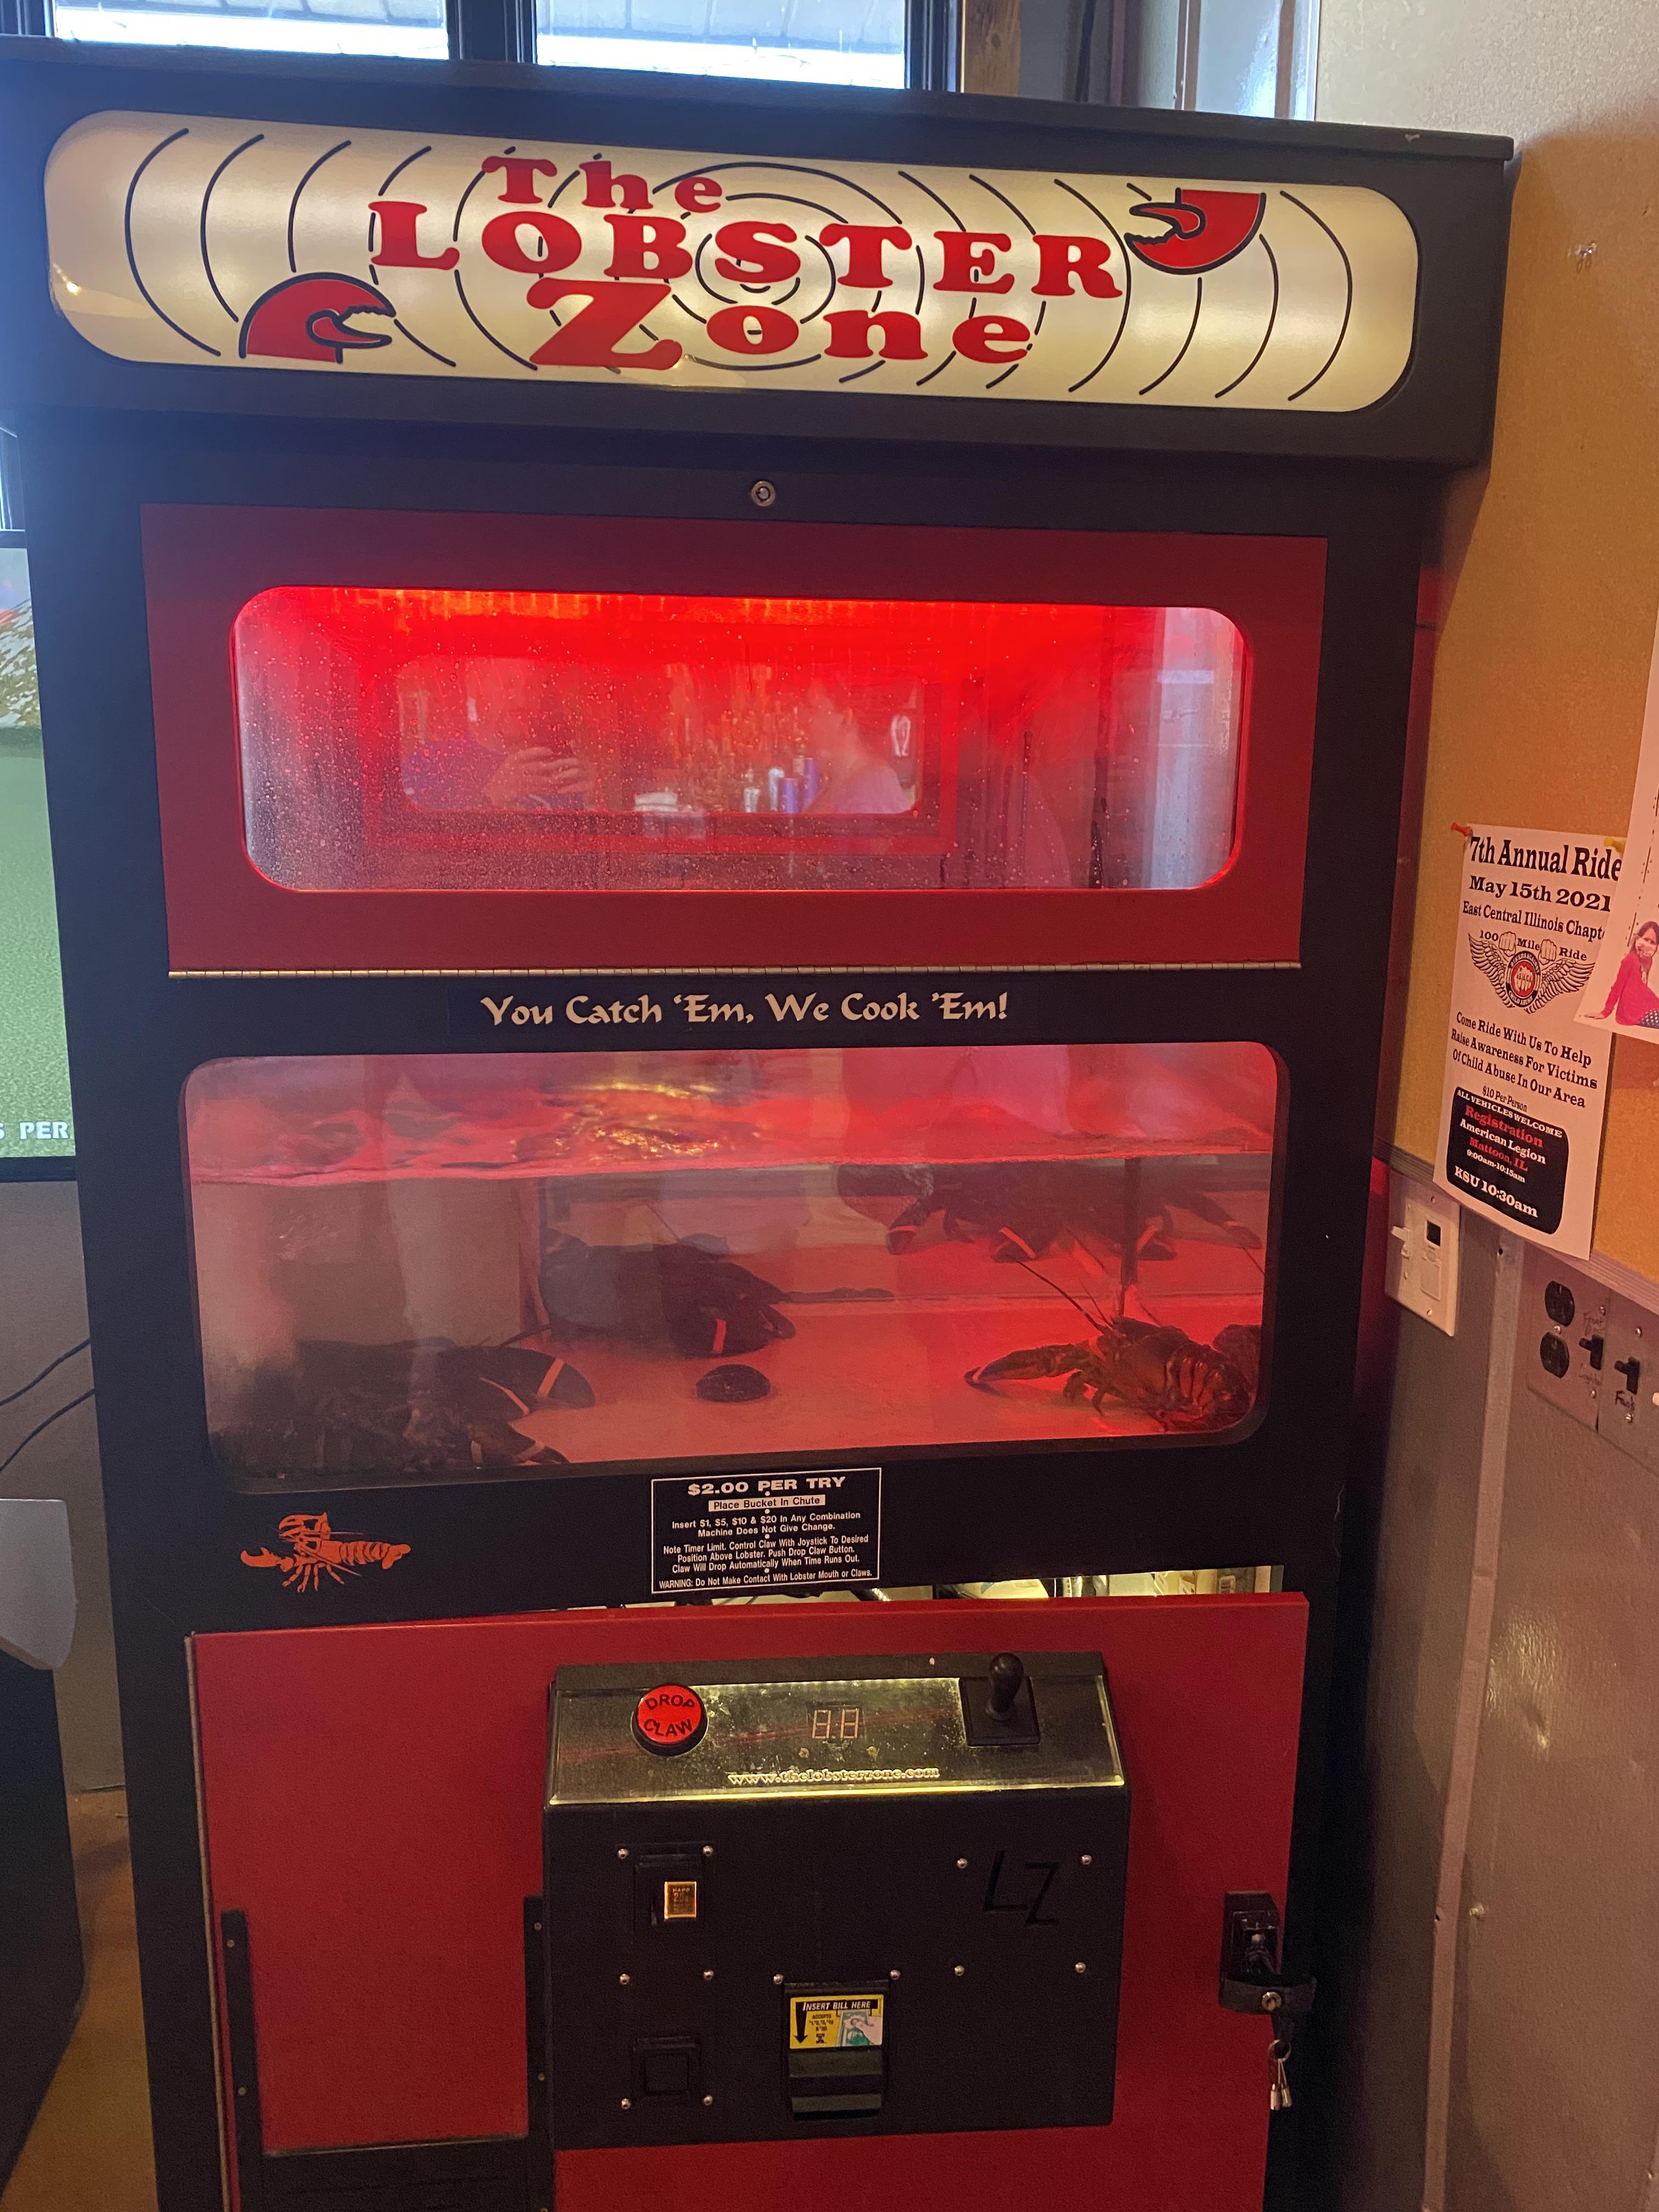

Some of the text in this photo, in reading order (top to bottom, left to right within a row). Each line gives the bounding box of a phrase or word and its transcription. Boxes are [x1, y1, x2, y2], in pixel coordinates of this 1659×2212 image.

[482, 153, 724, 214] The
[370, 200, 1124, 300] LOBSTER
[527, 278, 1032, 370] Zone
[1470, 836, 1622, 881] 7th Annual Ride
[1469, 875, 1611, 912] May 15th 2021
[1463, 900, 1481, 916] East
[1483, 905, 1522, 924] Central
[1524, 911, 1564, 932] Illinois
[1480, 930, 1587, 961] 100 Mile Ride
[481, 991, 1008, 1025] You Catch 'Em, We Cook 'Em!
[1457, 1012, 1592, 1068] Come Ride With Us To Help
[1451, 1029, 1598, 1089] Raise Awareness For Victims
[1453, 1048, 1585, 1108] Of Child Abuse In Our Area
[1457, 1090, 1562, 1138] ALL VEHICLES WELCOME
[1482, 1086, 1527, 1112] $10 Per Person
[20, 1121, 69, 1139] PER
[1460, 1119, 1546, 1164] American Legion
[1465, 1105, 1543, 1148] Registration
[1470, 1137, 1528, 1171] Mattoon, IL
[1455, 1165, 1538, 1218] KSU 10:30am
[687, 1476, 846, 1496] $2.00 PER TRY
[743, 1498, 777, 1508] Bucket
[793, 1497, 820, 1505] Chute
[698, 1528, 733, 1537] Machine
[699, 1519, 712, 1527] $1,
[715, 1519, 728, 1527] $5,
[760, 1515, 777, 1523] $20
[791, 1514, 806, 1522] Any
[810, 1511, 861, 1521] Combination
[663, 1534, 868, 1554] Note Timer Limit. Control Claw With Joystick To Desired
[678, 1554, 707, 1562] Position
[710, 1553, 732, 1561] Above
[736, 1551, 765, 1559] Lobster.
[769, 1549, 786, 1557] Push
[789, 1548, 805, 1556] Drop
[809, 1547, 826, 1555] Claw
[659, 1579, 693, 1589] WARNING:
[696, 1578, 705, 1587] Do
[708, 1577, 720, 1585] Not
[723, 1576, 741, 1584] Make
[743, 1574, 770, 1583] Contact
[790, 1572, 815, 1581] Lobster
[819, 1570, 839, 1579] Mouth
[851, 1568, 872, 1577] Claws.
[672, 1565, 690, 1573] Claw
[693, 1564, 706, 1572] Will
[709, 1562, 726, 1572] Drop
[729, 1558, 778, 1570] Automatically
[781, 1558, 802, 1566] When
[845, 1554, 860, 1562] Out.
[645, 1694, 695, 1710] DROP
[644, 1718, 692, 1736] CLAW
[727, 1768, 940, 1786] www.thelobsterzone.com
[803, 2002, 831, 2011] INSERT
